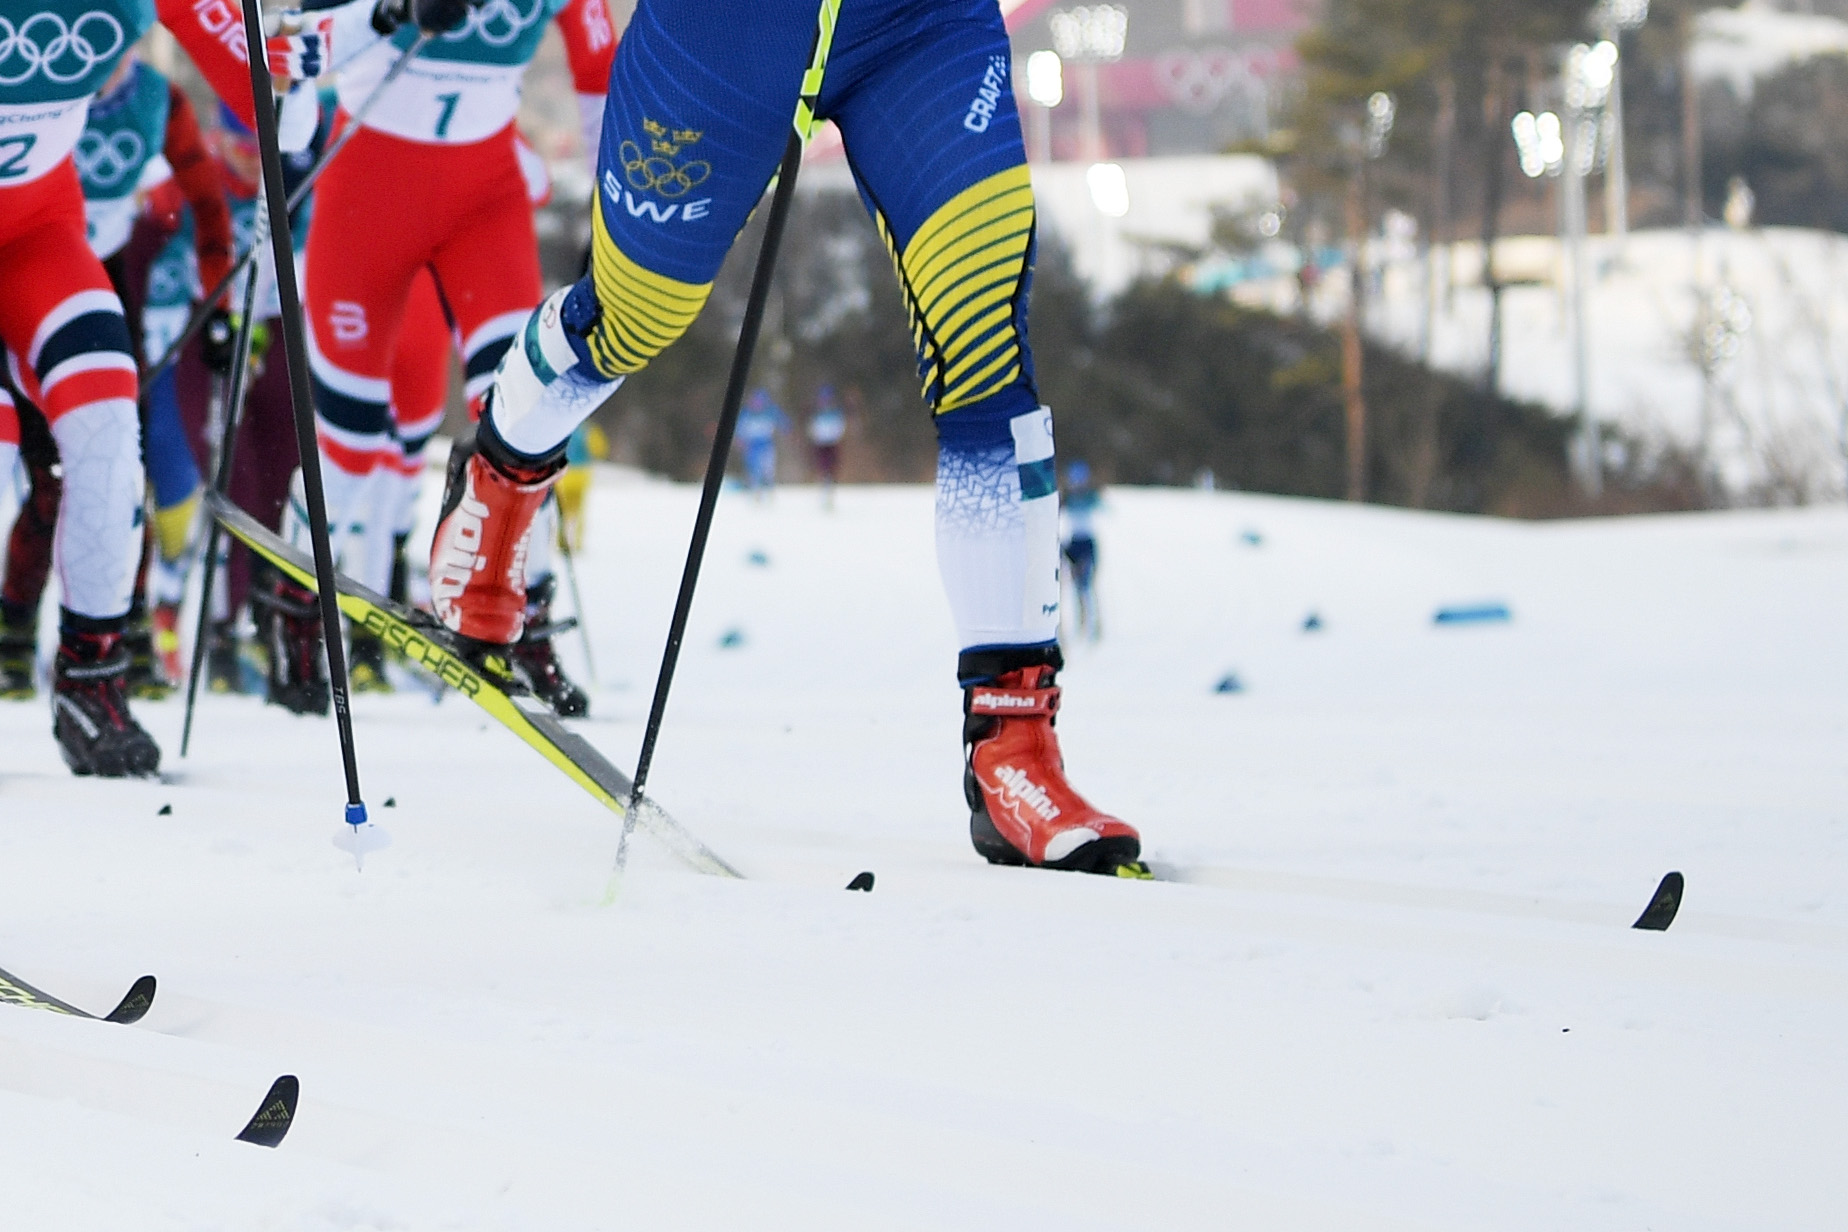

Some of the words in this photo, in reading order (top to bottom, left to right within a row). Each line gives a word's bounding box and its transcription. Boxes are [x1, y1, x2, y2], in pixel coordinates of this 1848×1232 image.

[434, 92, 461, 139] 1
[963, 64, 1004, 134] CRAFT
[603, 169, 712, 223] SWE
[364, 609, 481, 700] FISCHER
[973, 692, 1036, 709] alpina
[994, 765, 1062, 822] alpina
